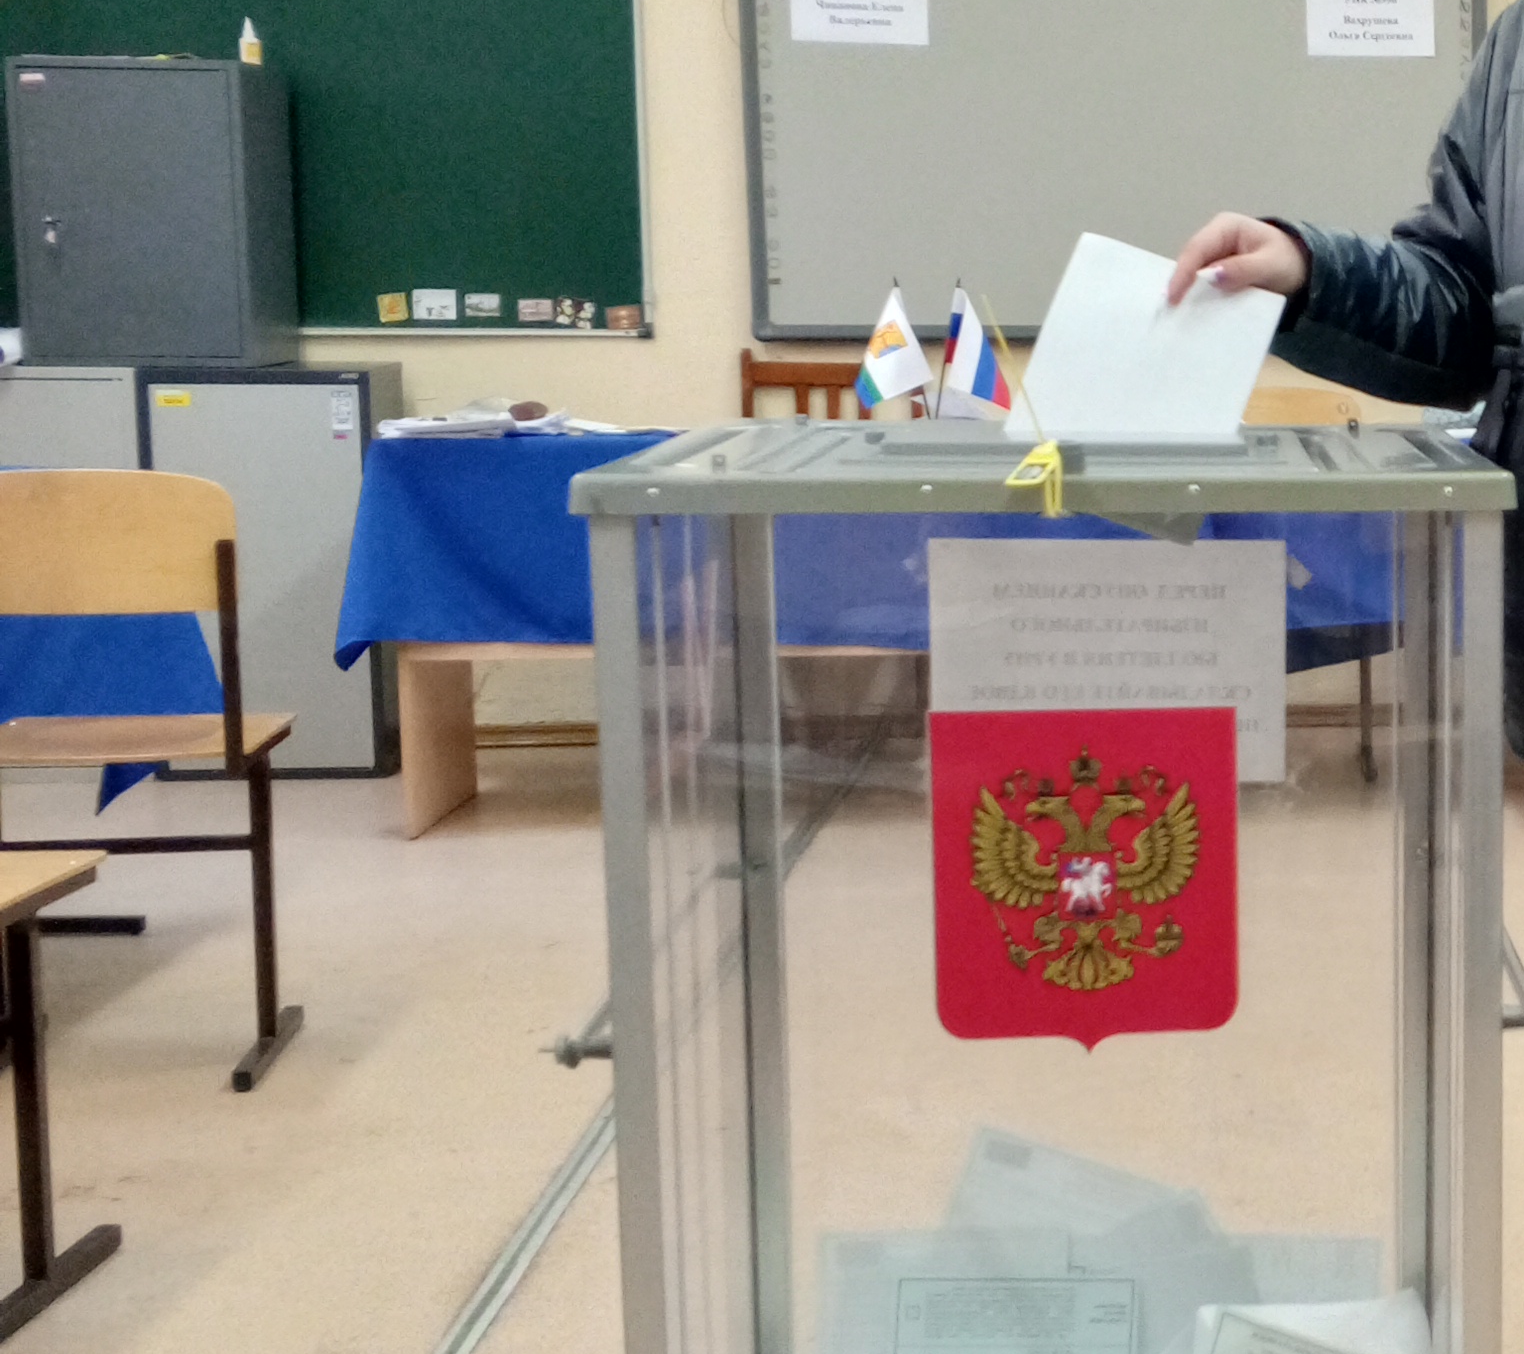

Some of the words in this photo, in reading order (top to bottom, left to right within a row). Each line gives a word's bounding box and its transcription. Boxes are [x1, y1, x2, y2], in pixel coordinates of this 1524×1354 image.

[1343, 15, 1399, 27] Вахрушева
[1328, 30, 1360, 41] Ольга
[1362, 30, 1414, 43] Сергеевна
